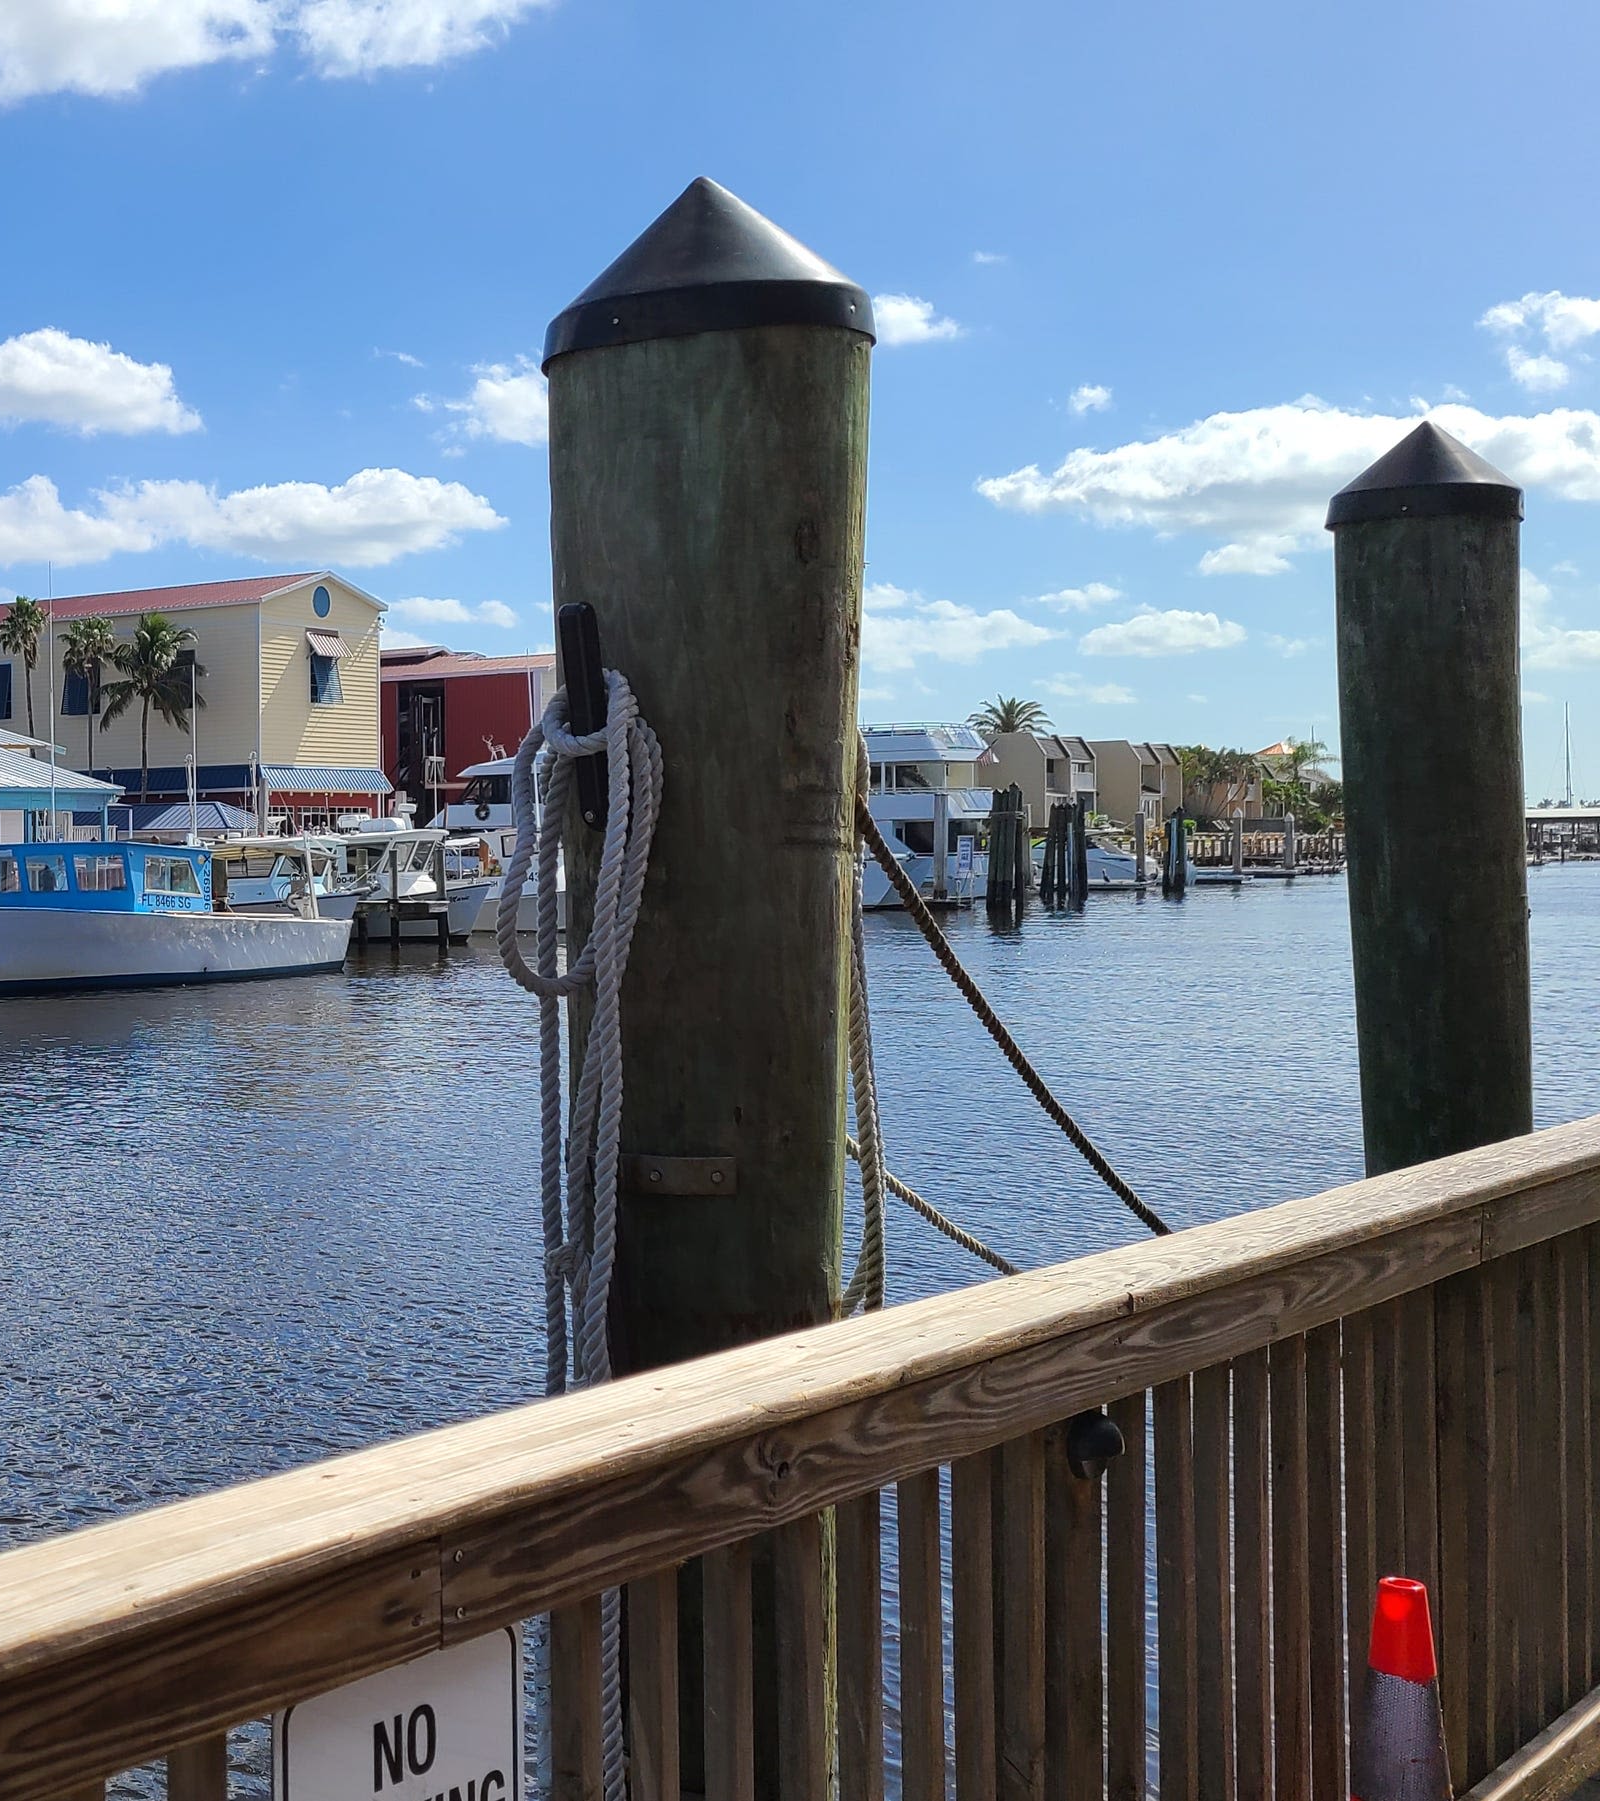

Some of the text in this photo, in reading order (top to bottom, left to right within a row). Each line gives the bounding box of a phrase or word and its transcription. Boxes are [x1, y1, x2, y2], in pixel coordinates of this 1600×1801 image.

[141, 894, 192, 909] FL 8466 SG
[373, 1703, 437, 1793] NO
